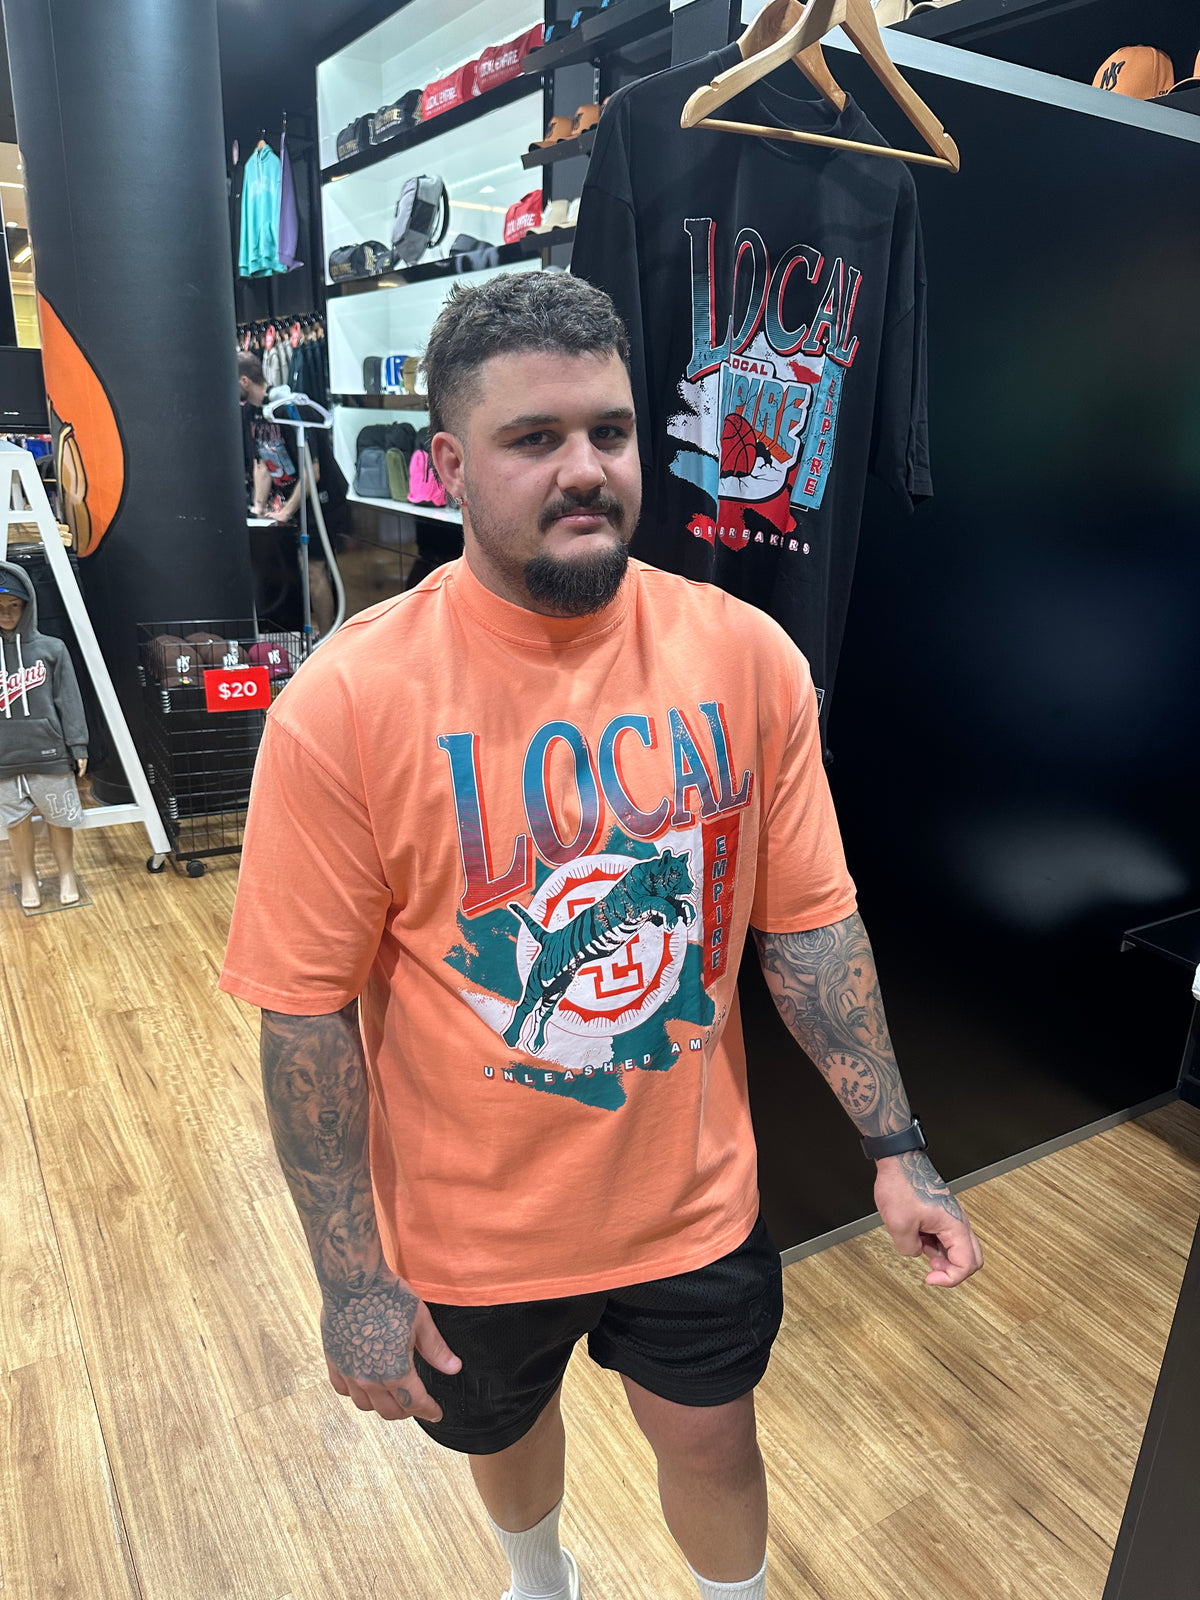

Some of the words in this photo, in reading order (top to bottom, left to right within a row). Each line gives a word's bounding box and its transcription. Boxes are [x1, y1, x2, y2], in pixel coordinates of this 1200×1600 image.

[684, 217, 862, 381] LOCAL
[730, 358, 768, 376] OCAL
[803, 378, 837, 496] EMPIRE
[218, 681, 258, 700] $20
[436, 701, 754, 918] LOCAL
[711, 834, 727, 969] EMPIRE
[484, 1053, 653, 1084] UNLEASHED
